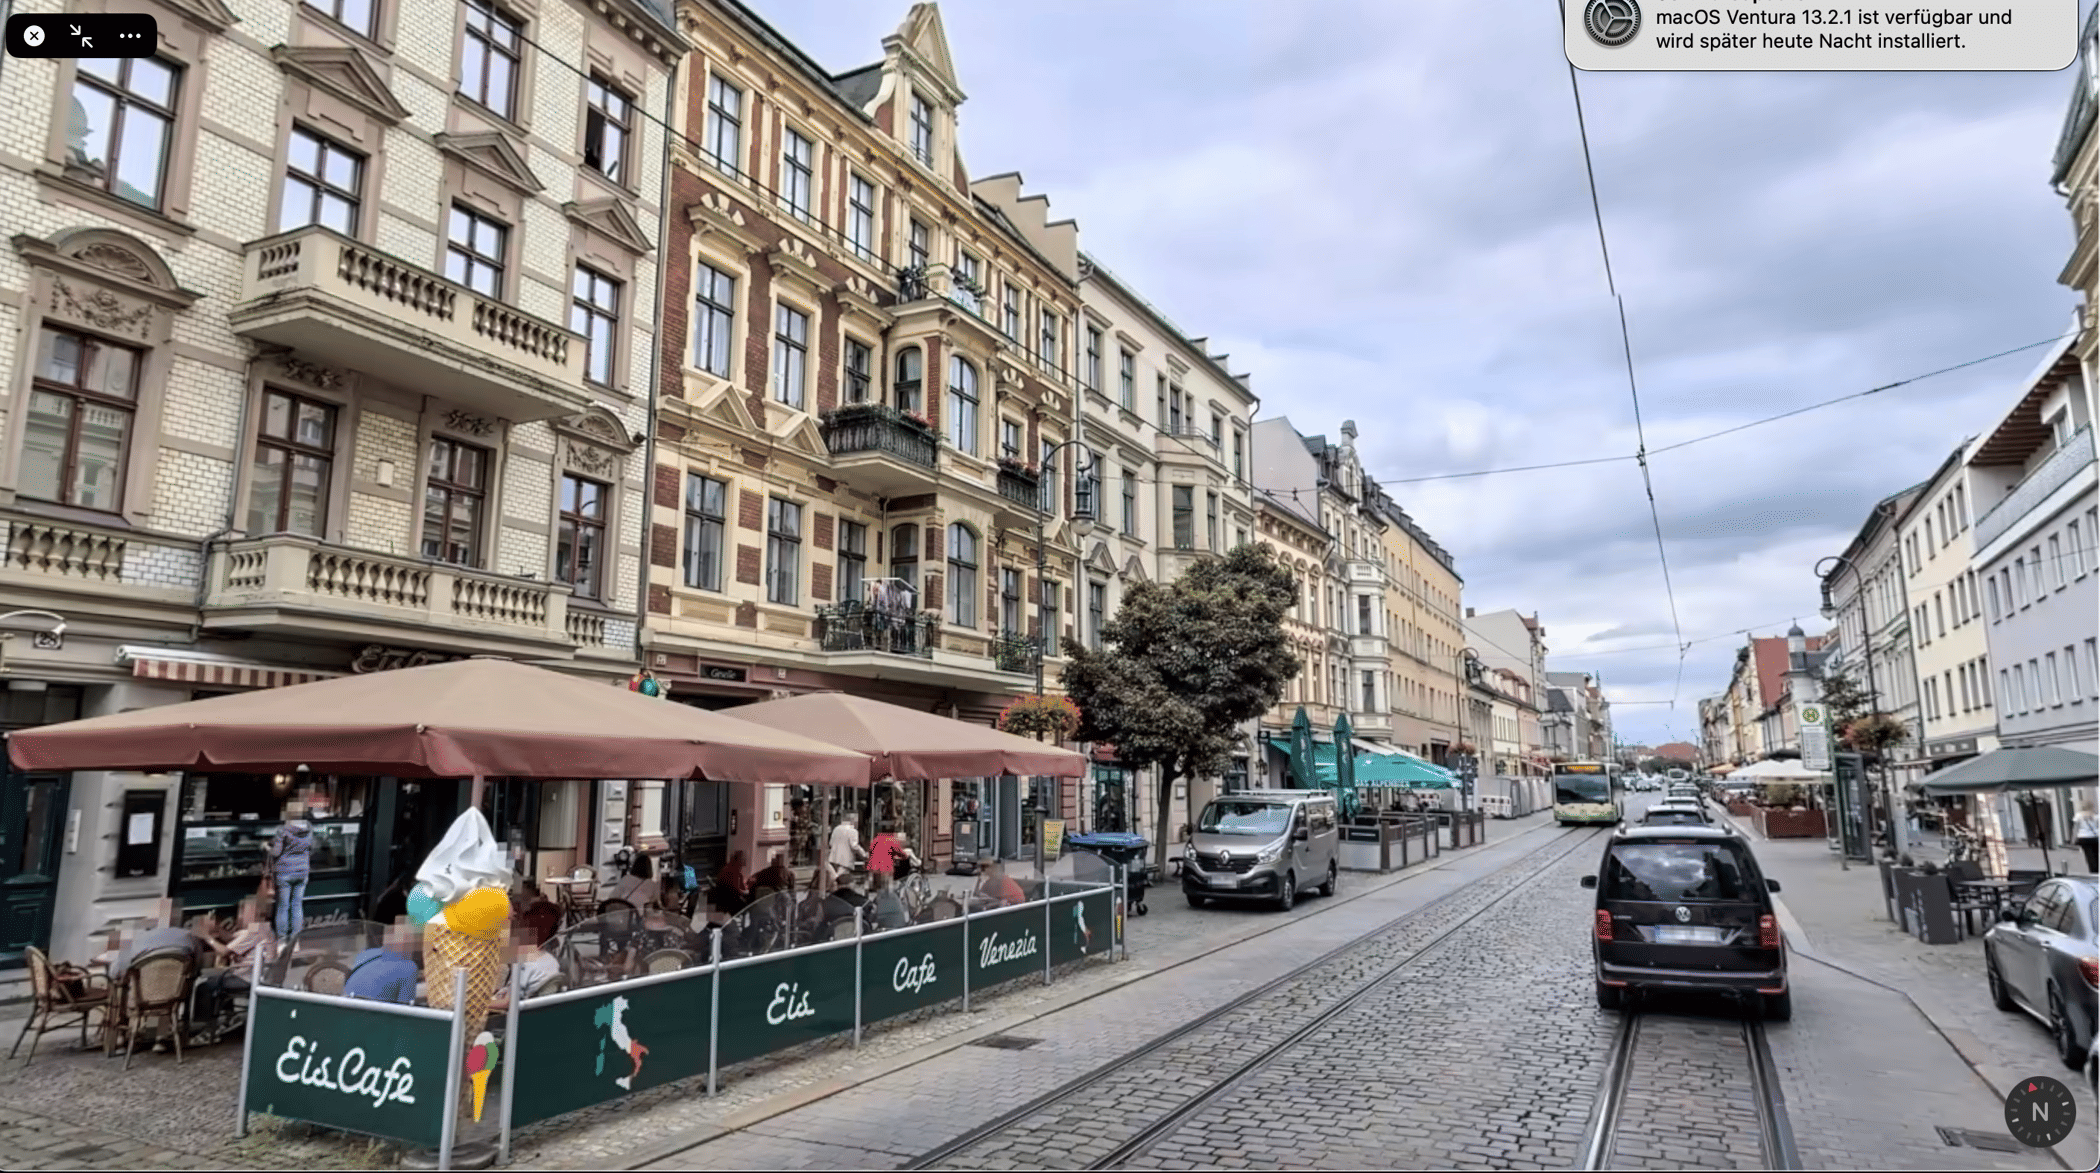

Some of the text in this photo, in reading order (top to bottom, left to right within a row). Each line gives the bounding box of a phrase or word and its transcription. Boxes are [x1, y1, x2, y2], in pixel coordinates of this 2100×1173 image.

[766, 929, 1037, 1025] Eis Cafe Venezia
